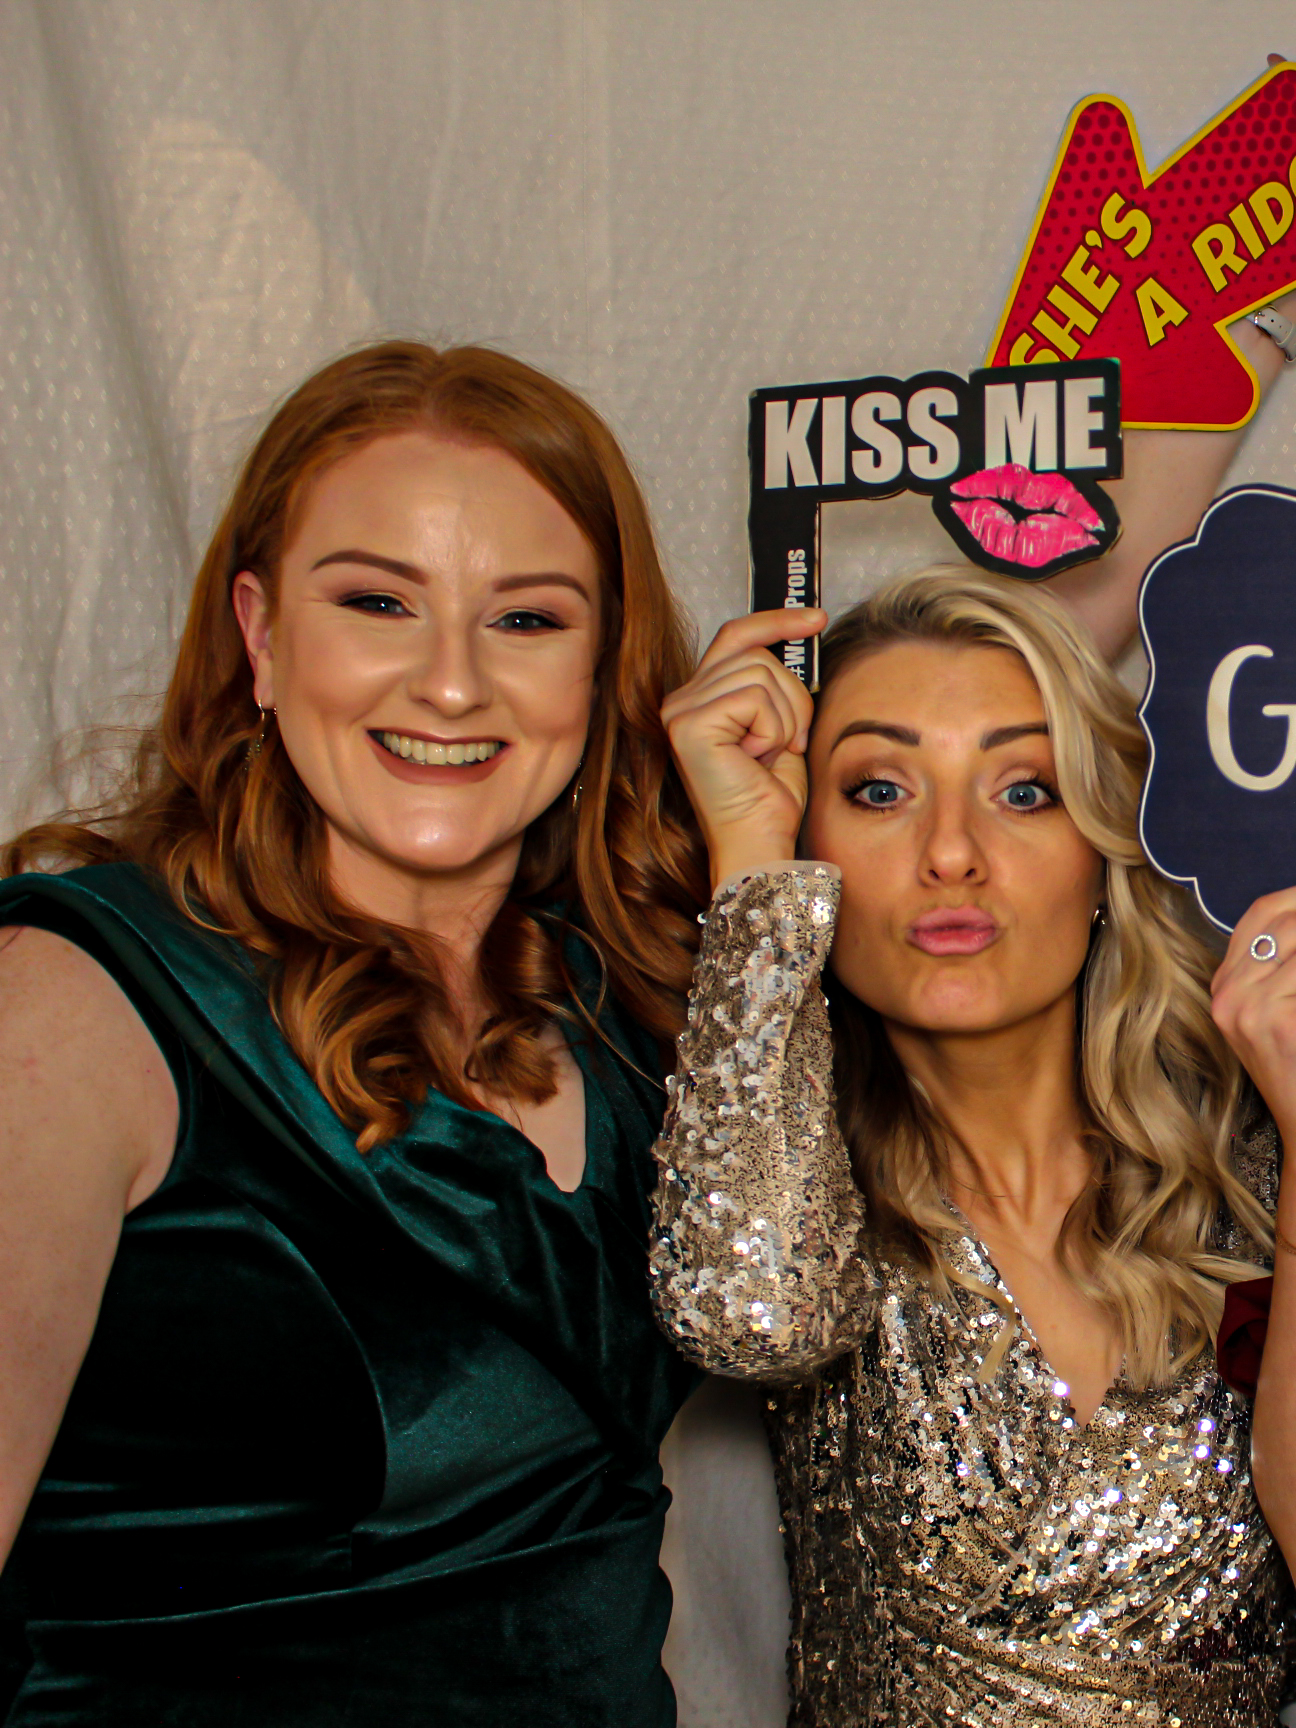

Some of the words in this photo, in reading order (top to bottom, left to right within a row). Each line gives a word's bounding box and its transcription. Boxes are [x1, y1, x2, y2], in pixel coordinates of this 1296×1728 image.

[1008, 192, 1152, 366] SHE'S
[1135, 277, 1189, 347] A
[764, 387, 961, 490] KISS
[984, 376, 1107, 472] ME
